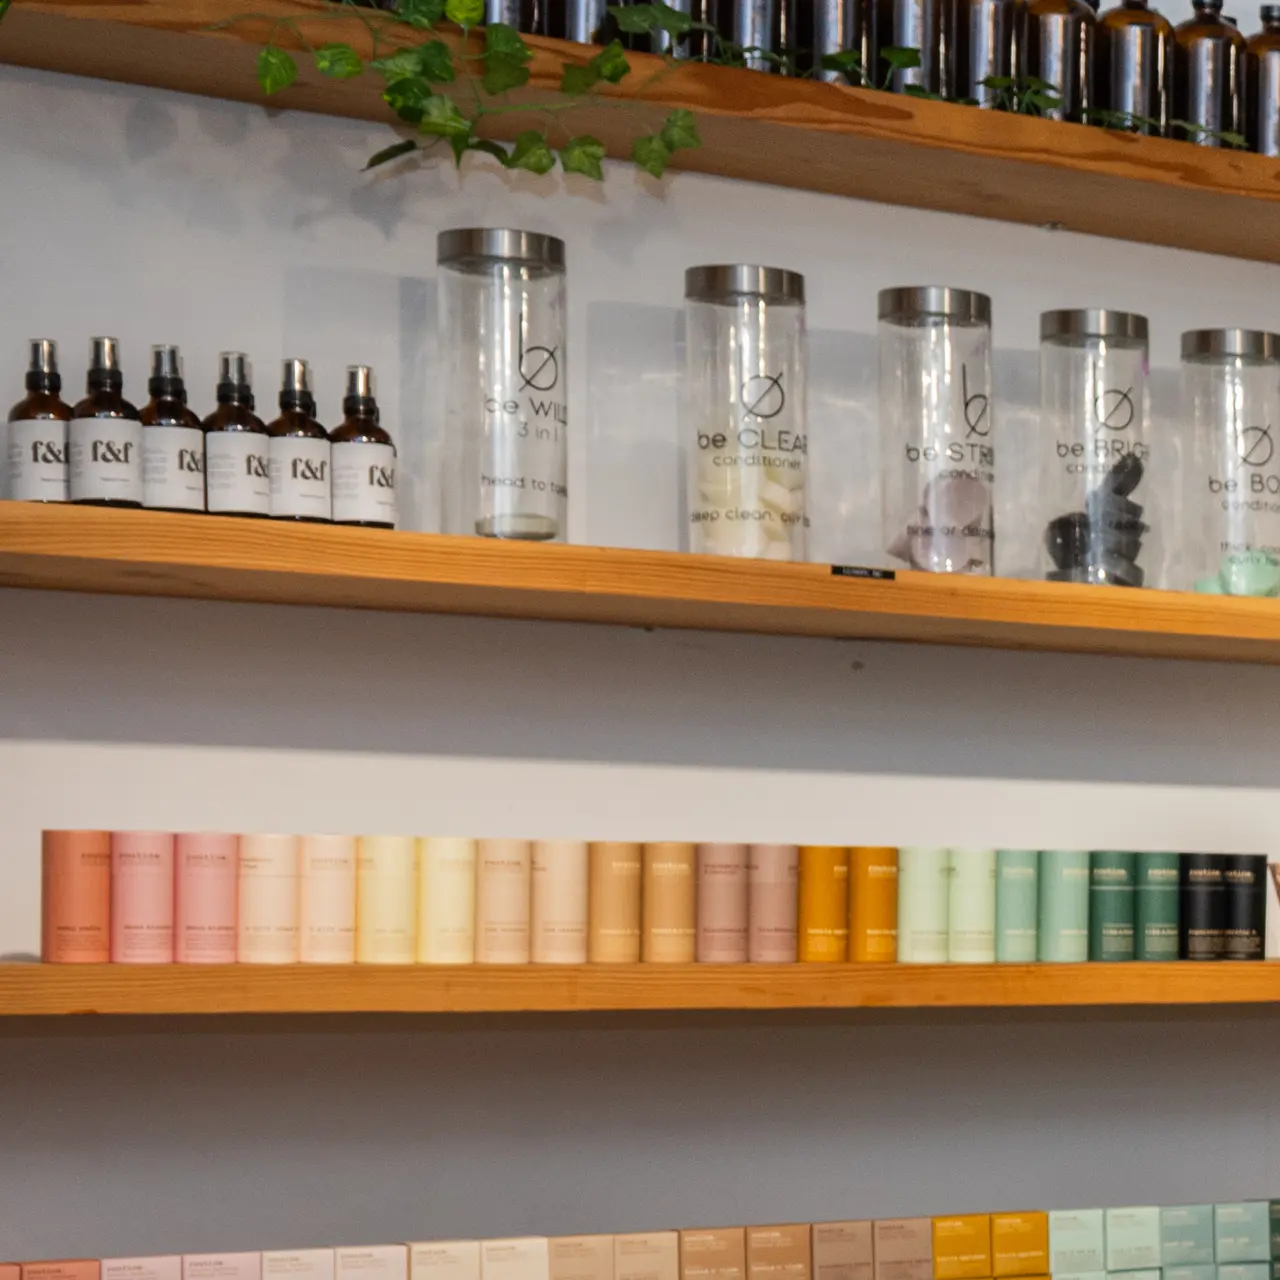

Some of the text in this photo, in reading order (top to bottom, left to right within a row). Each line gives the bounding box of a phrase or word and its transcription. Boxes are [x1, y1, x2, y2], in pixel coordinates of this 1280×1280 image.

[92, 440, 133, 464] f&f
[697, 430, 727, 450] be
[1056, 440, 1084, 458] be
[178, 449, 205, 474] f&
[246, 454, 271, 479] f&
[291, 457, 327, 481] f&f
